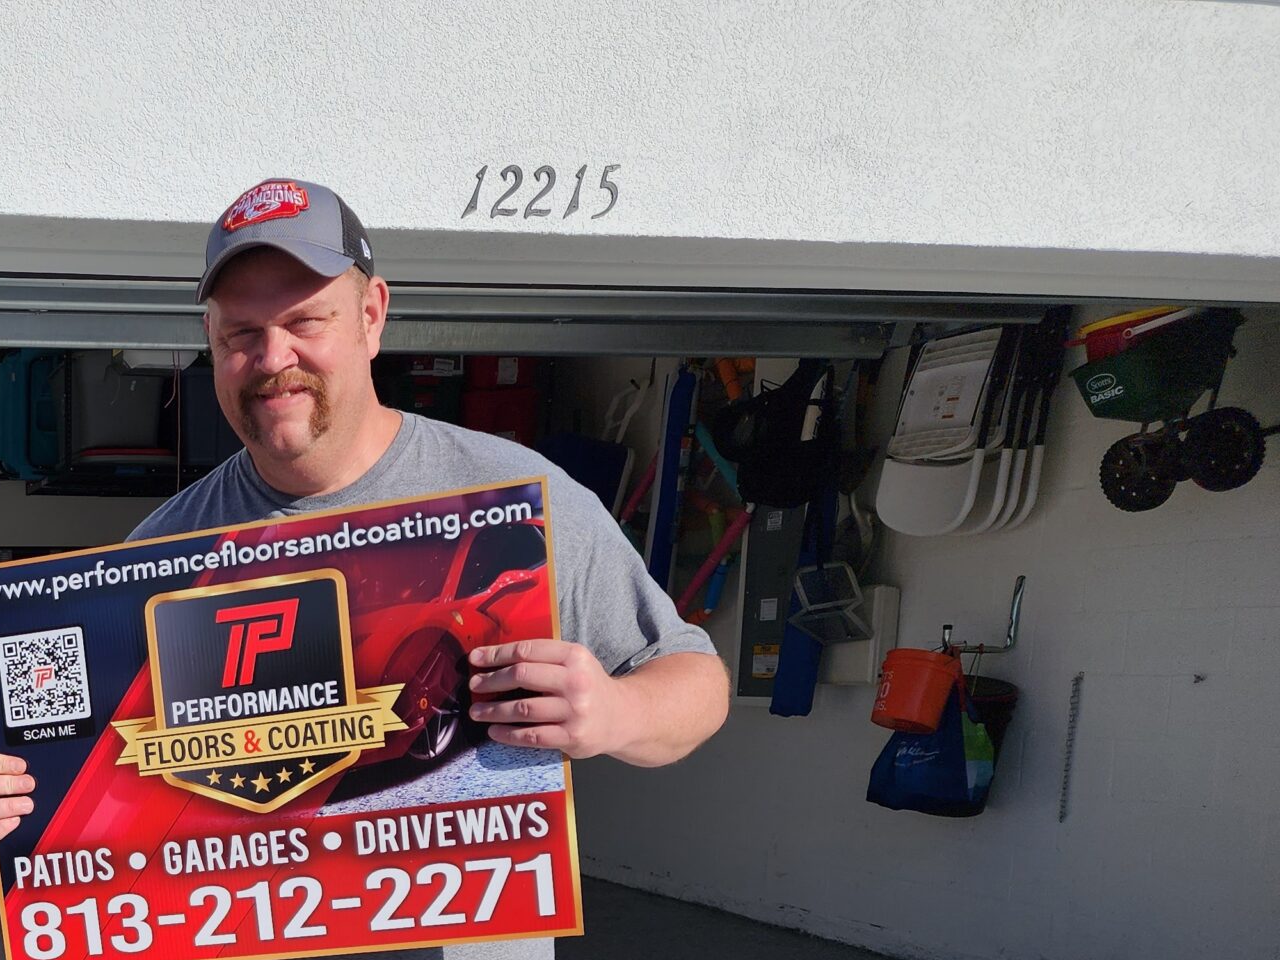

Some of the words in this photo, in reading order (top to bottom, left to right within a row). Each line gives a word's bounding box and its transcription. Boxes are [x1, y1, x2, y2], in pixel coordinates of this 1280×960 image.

[231, 189, 304, 218] CHAMPIONS
[461, 164, 621, 219] 12215
[1090, 386, 1124, 404] BASIC
[171, 680, 339, 724] PERFORMANCE
[23, 727, 56, 741] SCAN
[58, 724, 77, 737] ME
[143, 732, 236, 766] FLOORS
[243, 729, 263, 754] &
[268, 714, 375, 751] COATING
[14, 847, 115, 889] PATIOS
[163, 827, 310, 875] GARAGES
[355, 801, 549, 856] DRIVEWAYS
[21, 853, 556, 960] 813-212-2271
